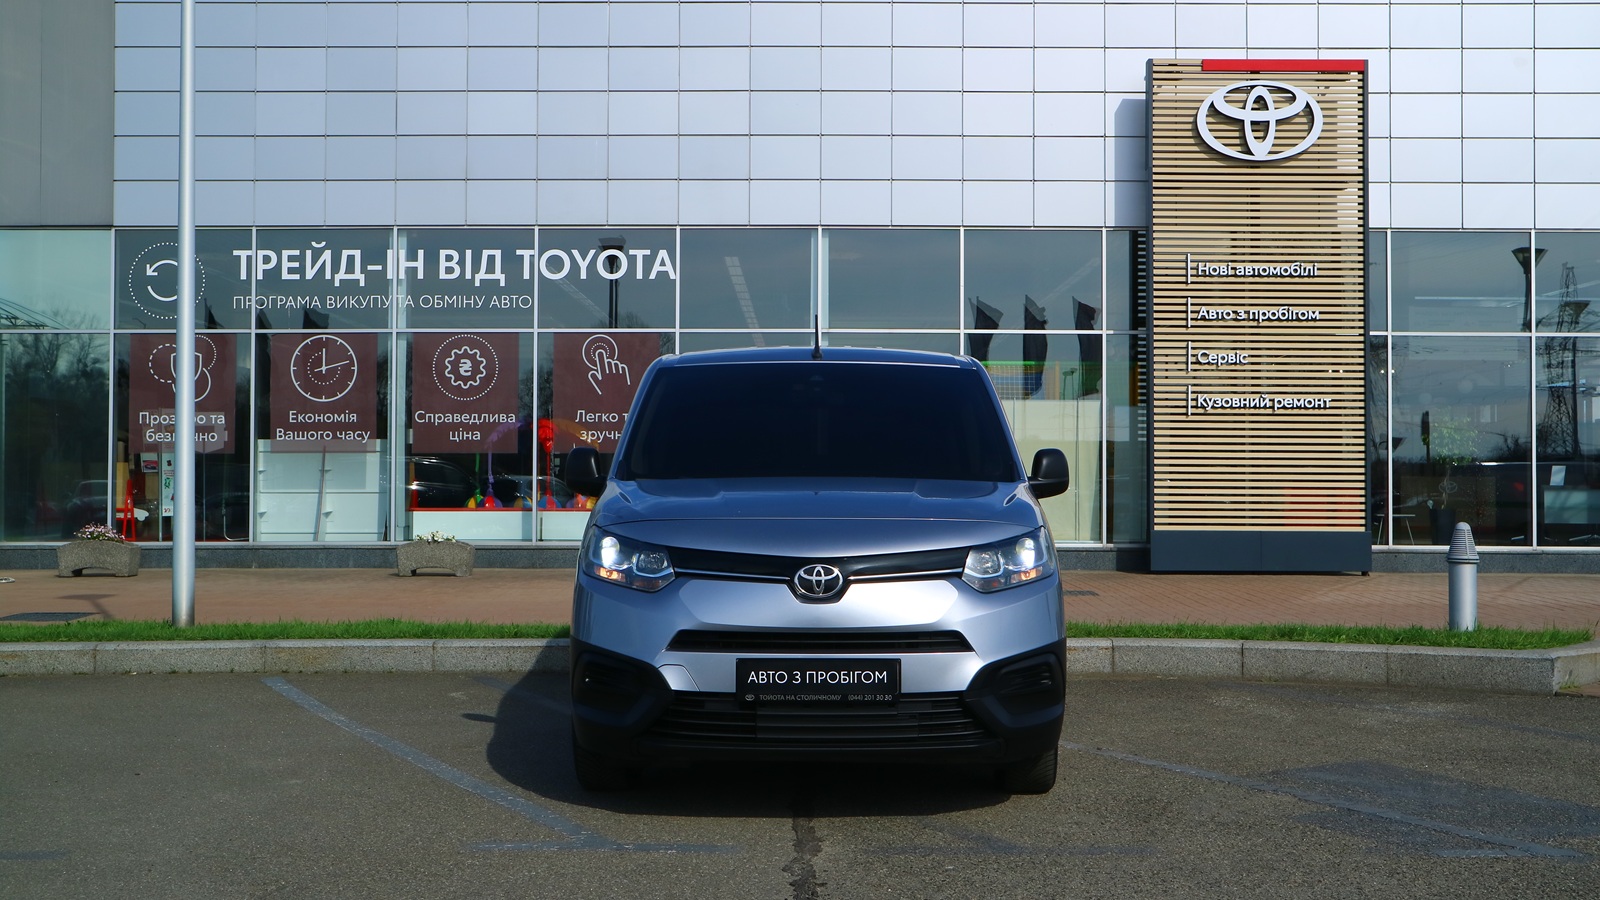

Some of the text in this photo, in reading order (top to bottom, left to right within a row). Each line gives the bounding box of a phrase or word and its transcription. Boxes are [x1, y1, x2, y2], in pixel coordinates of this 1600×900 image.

[233, 241, 676, 287] ТРЕЙД-ІН ВІД TOYOTA
[1198, 262, 1318, 276] Нові автомобілі
[233, 295, 532, 309] ПРОГРАМА ВИКУПУ ТА ОБМІНУ АВТО
[1197, 306, 1320, 323] Авто з пробігом
[1197, 350, 1249, 366] Сервіс
[1197, 394, 1331, 412] Кузовний ремонт
[139, 411, 225, 427] Прозо та
[289, 410, 357, 423] Економія
[415, 410, 516, 427] Справедлива
[575, 410, 619, 423] Легко
[276, 429, 371, 443] Вашого часу
[449, 427, 481, 442] ціна
[580, 430, 623, 443] зручн
[747, 671, 887, 684] АВТО З ПРОБІГОМ
[848, 694, 863, 702] (044)
